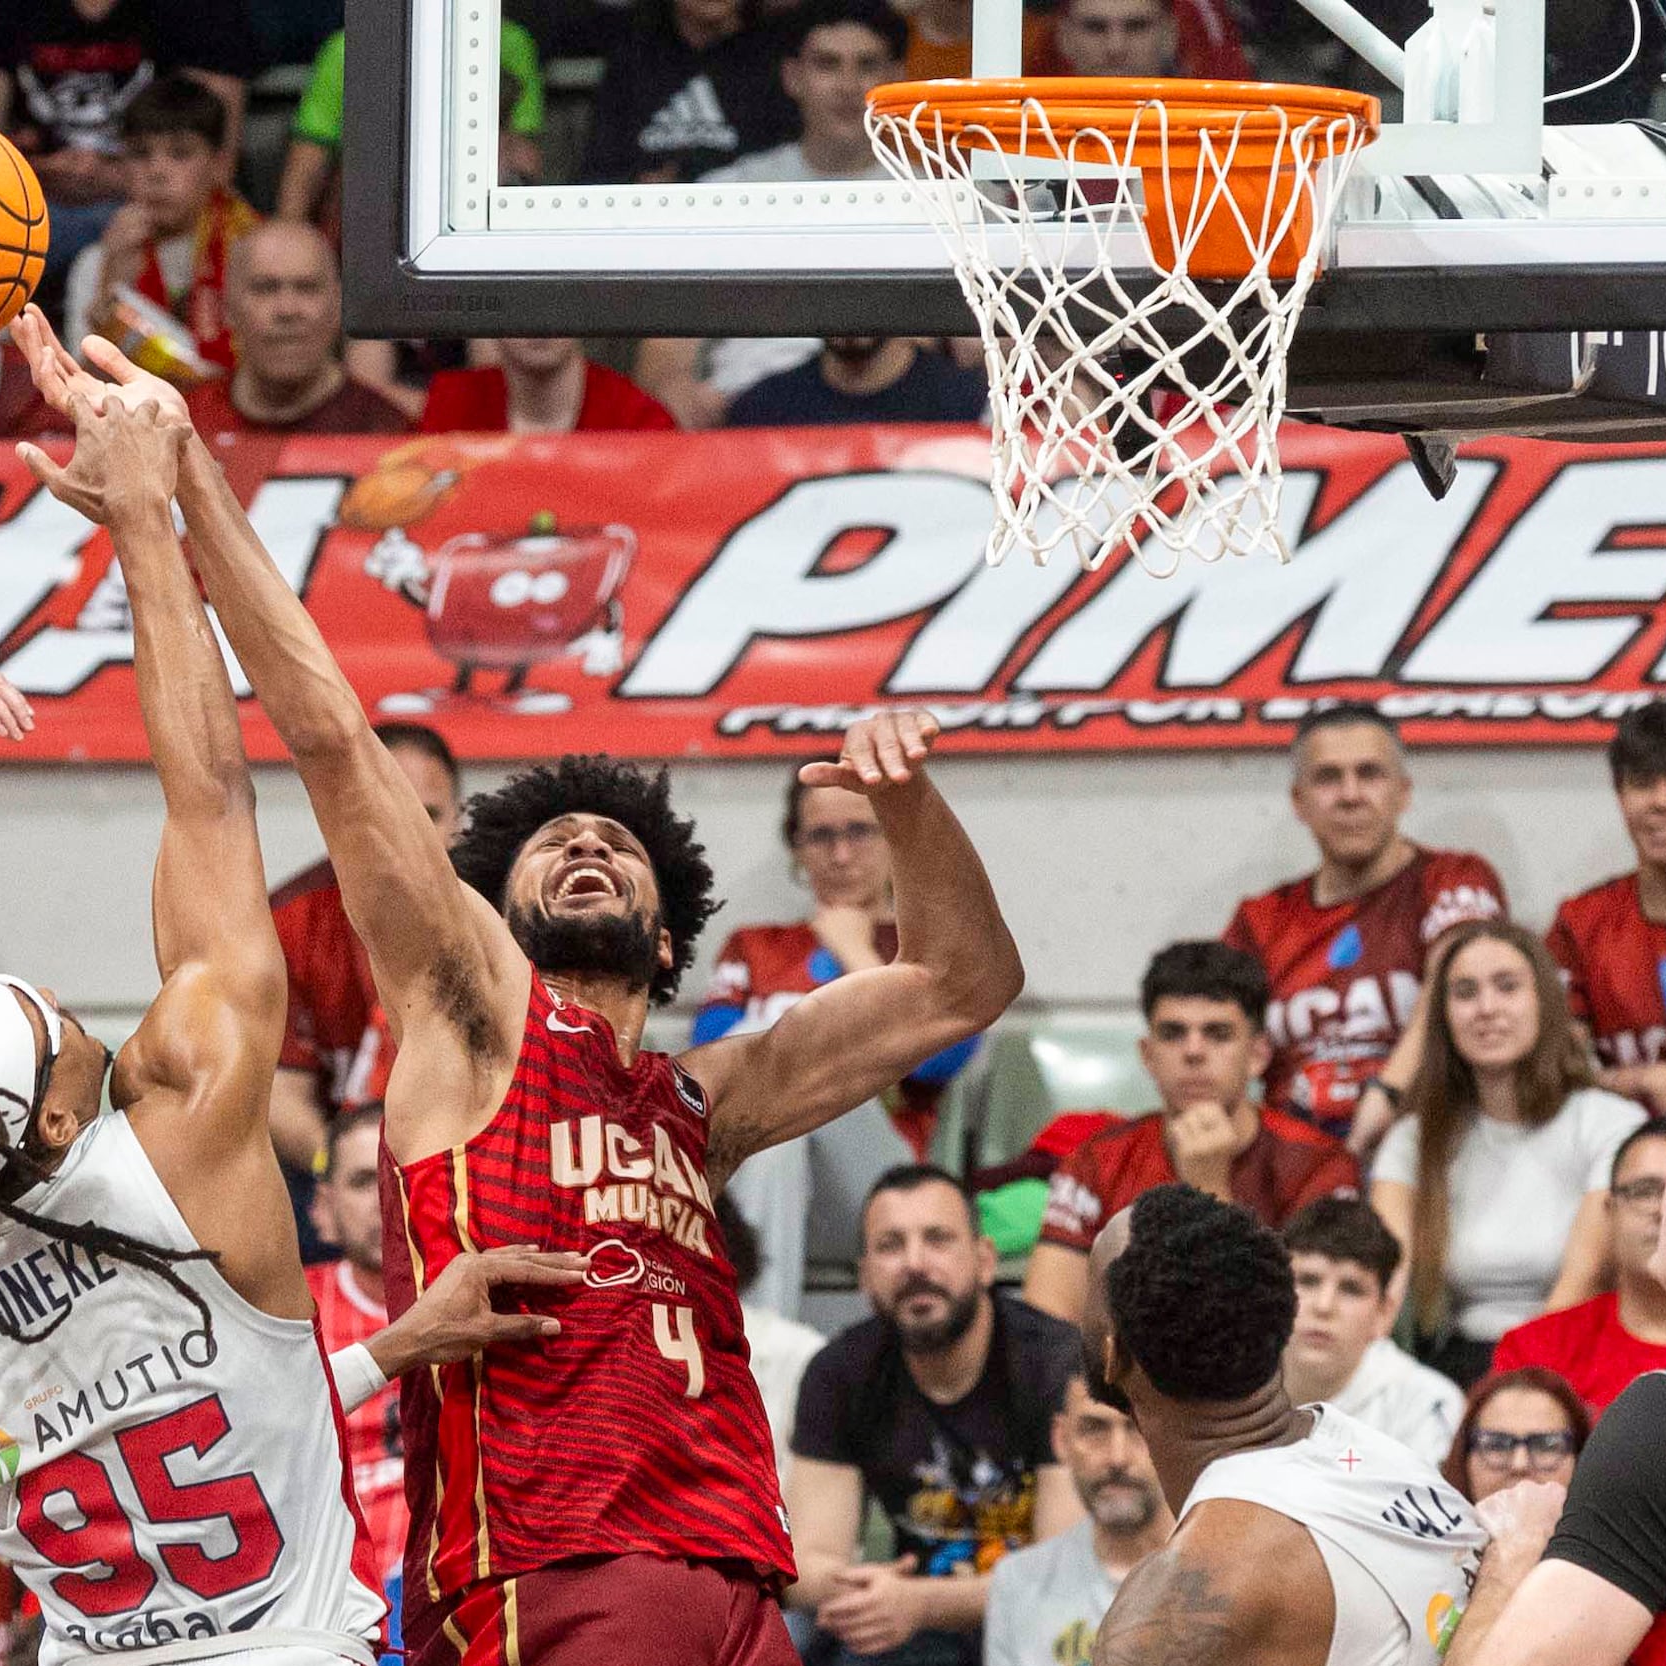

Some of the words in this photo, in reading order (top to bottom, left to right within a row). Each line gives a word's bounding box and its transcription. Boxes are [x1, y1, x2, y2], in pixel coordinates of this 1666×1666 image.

[33, 1329, 218, 1453] AMUTIO
[651, 1302, 704, 1399] 4
[16, 1391, 286, 1618] 95
